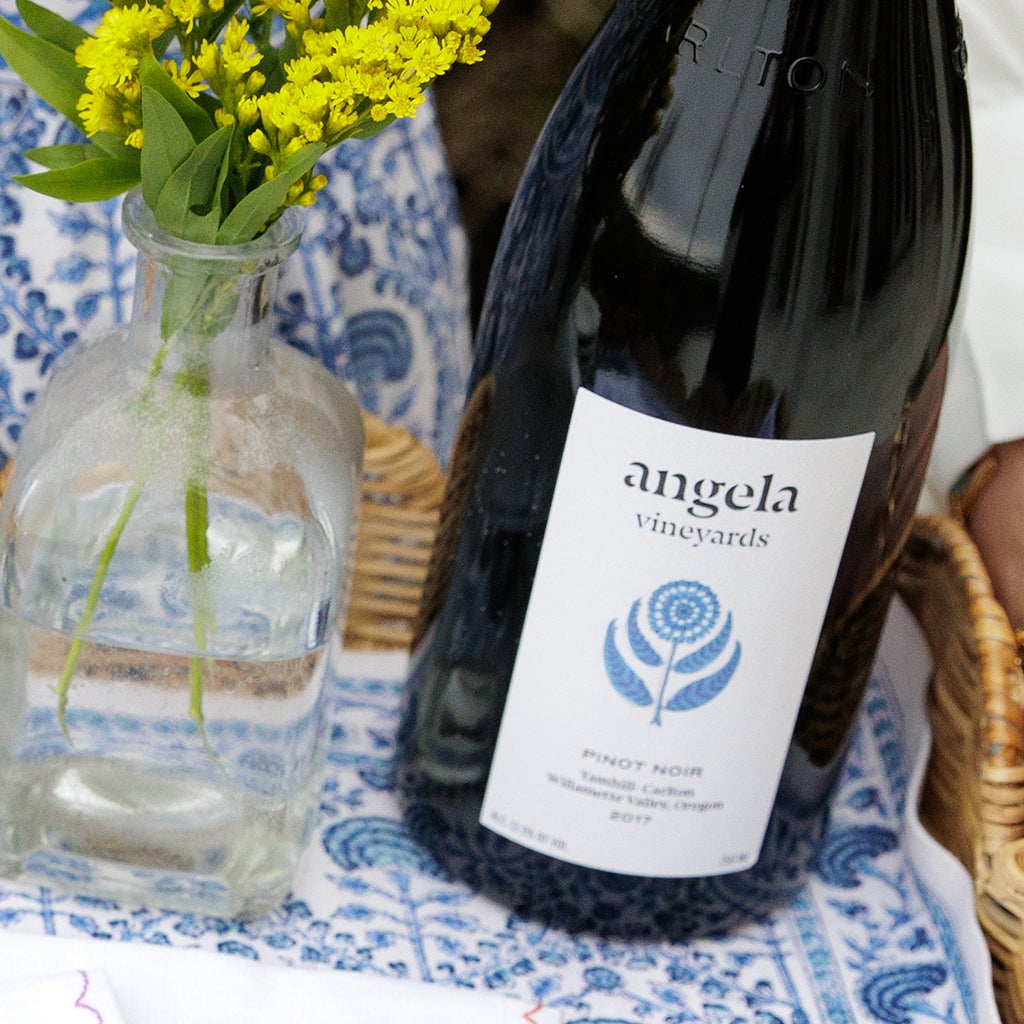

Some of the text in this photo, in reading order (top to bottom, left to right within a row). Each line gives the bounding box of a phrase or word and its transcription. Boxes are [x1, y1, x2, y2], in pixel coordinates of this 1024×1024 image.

[624, 461, 799, 519] angela
[636, 512, 771, 548] vineyards
[582, 748, 704, 778] PINOT NOIR
[609, 808, 653, 825] 2017
